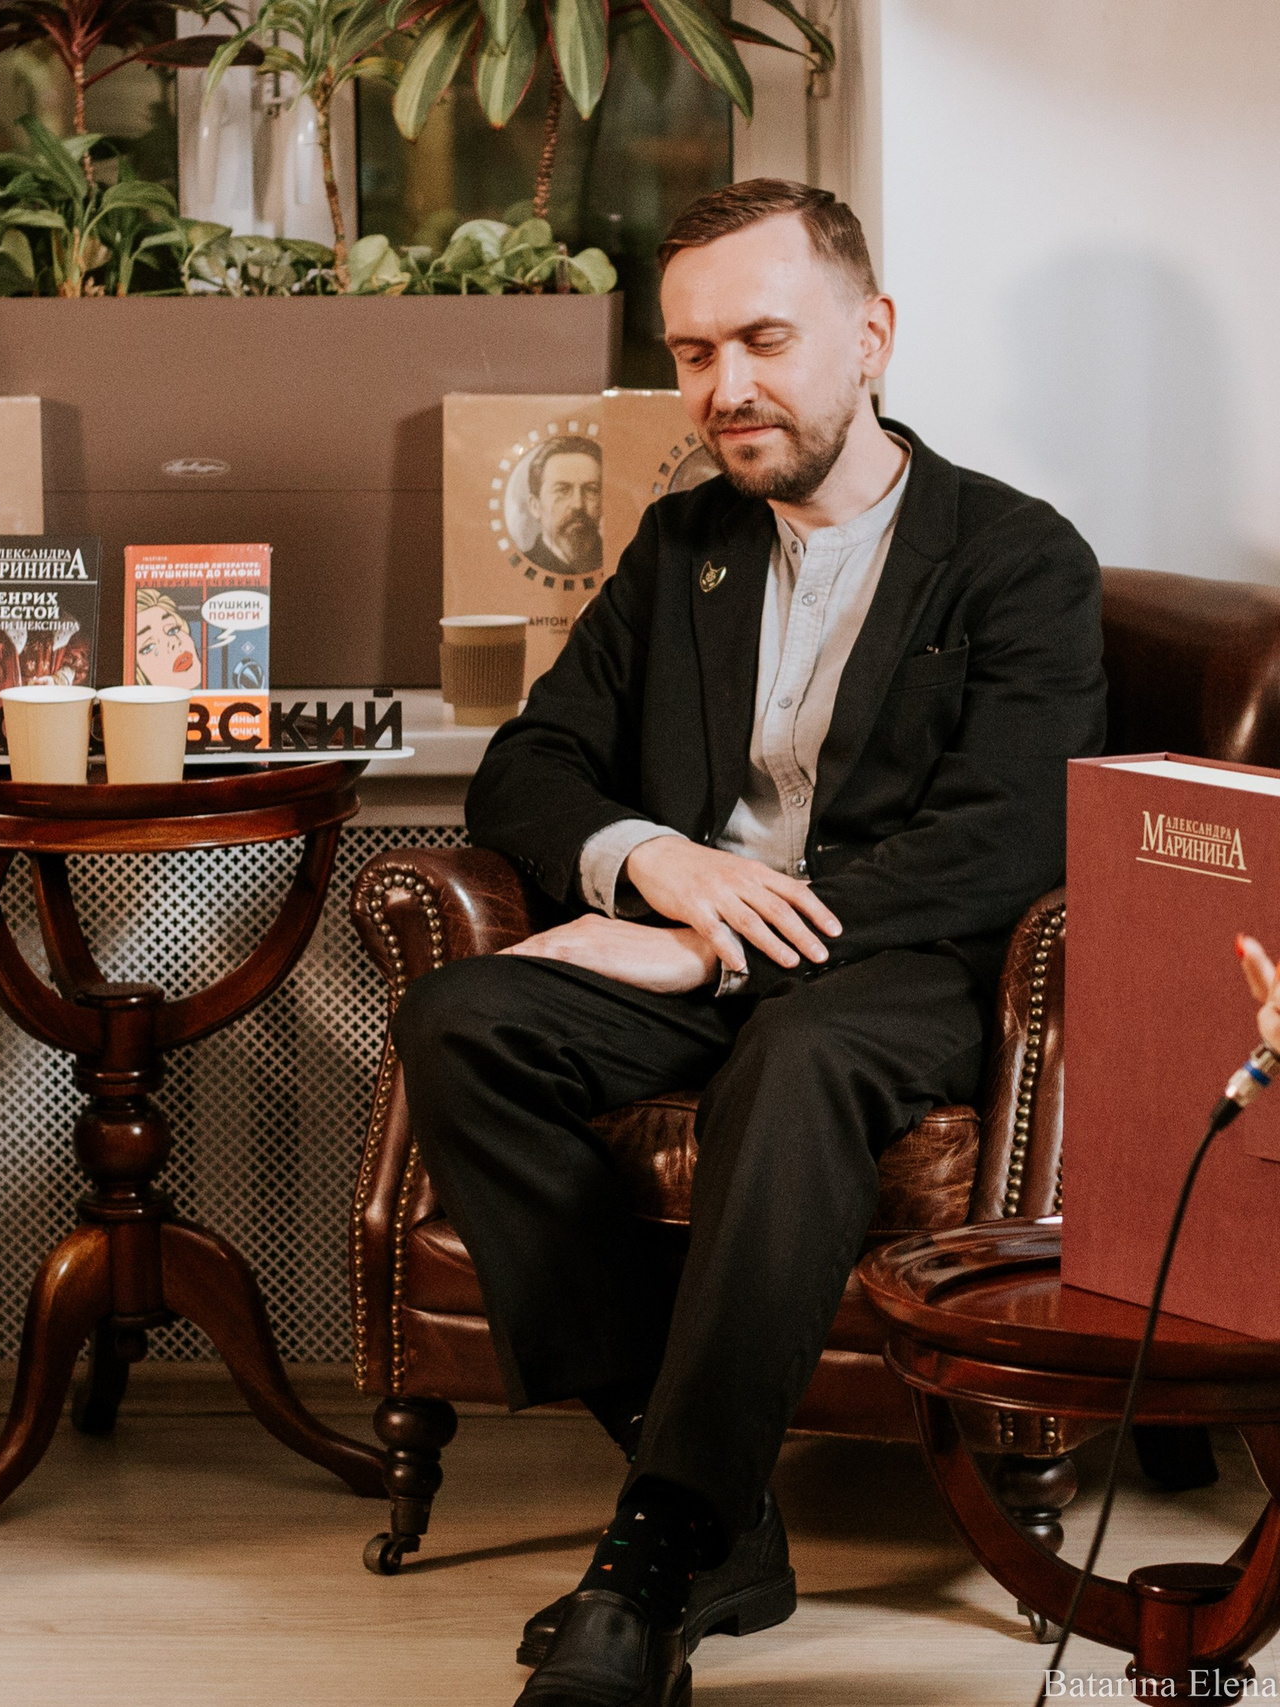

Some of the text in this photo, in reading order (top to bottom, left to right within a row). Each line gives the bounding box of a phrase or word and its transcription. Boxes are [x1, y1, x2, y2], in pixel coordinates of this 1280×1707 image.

[135, 569, 261, 579] ОТ ПУШКИНА ДО КАФКИ
[209, 601, 263, 610] ПУШКИН,
[209, 611, 260, 620] ПОМОГИ
[16, 620, 80, 631] ШЕКСПИРА
[529, 616, 567, 626] АНТОН
[1165, 817, 1232, 840] АЛЕКСАНДРА
[1141, 810, 1247, 870] МАРИНИНА
